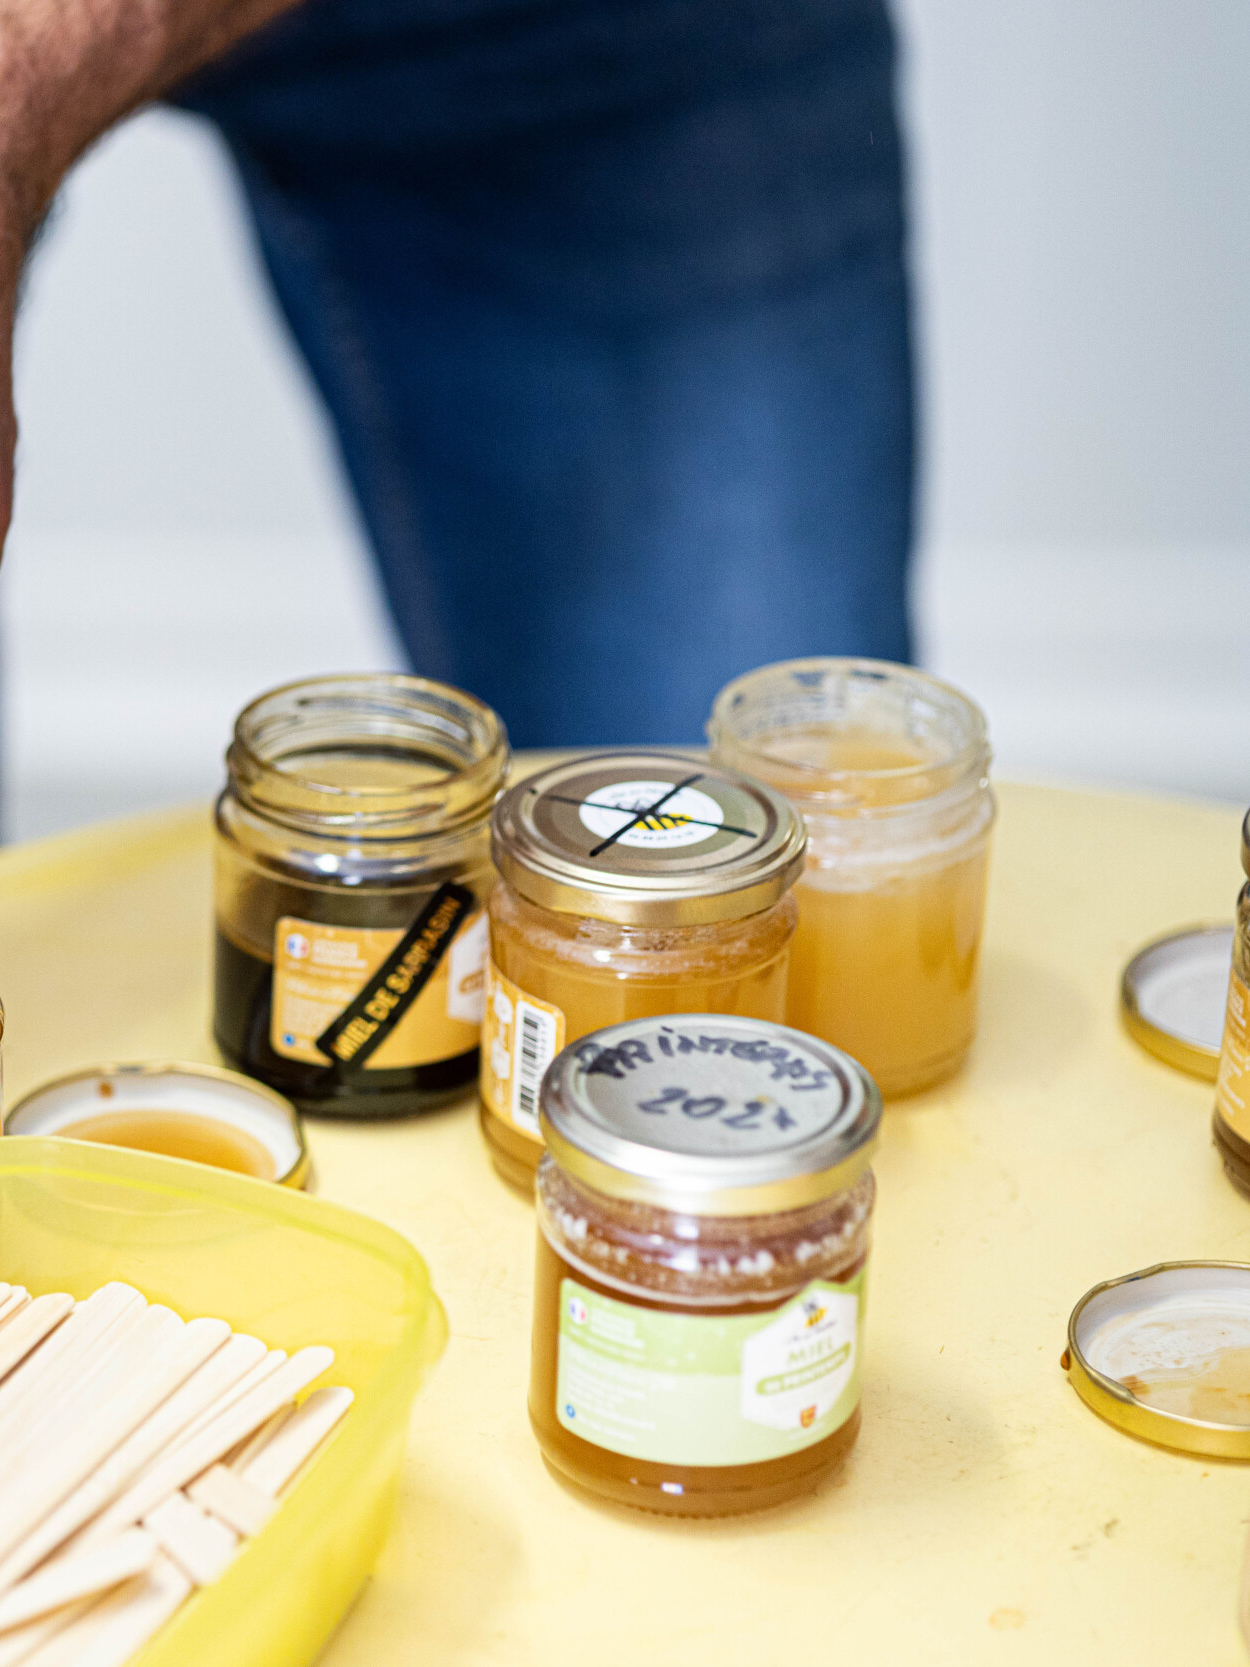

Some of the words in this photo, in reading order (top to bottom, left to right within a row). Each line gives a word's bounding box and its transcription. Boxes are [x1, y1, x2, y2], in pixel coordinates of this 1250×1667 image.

[331, 1016, 380, 1061] MIEL
[364, 987, 400, 1022] DE
[386, 896, 461, 994] SARRASIN
